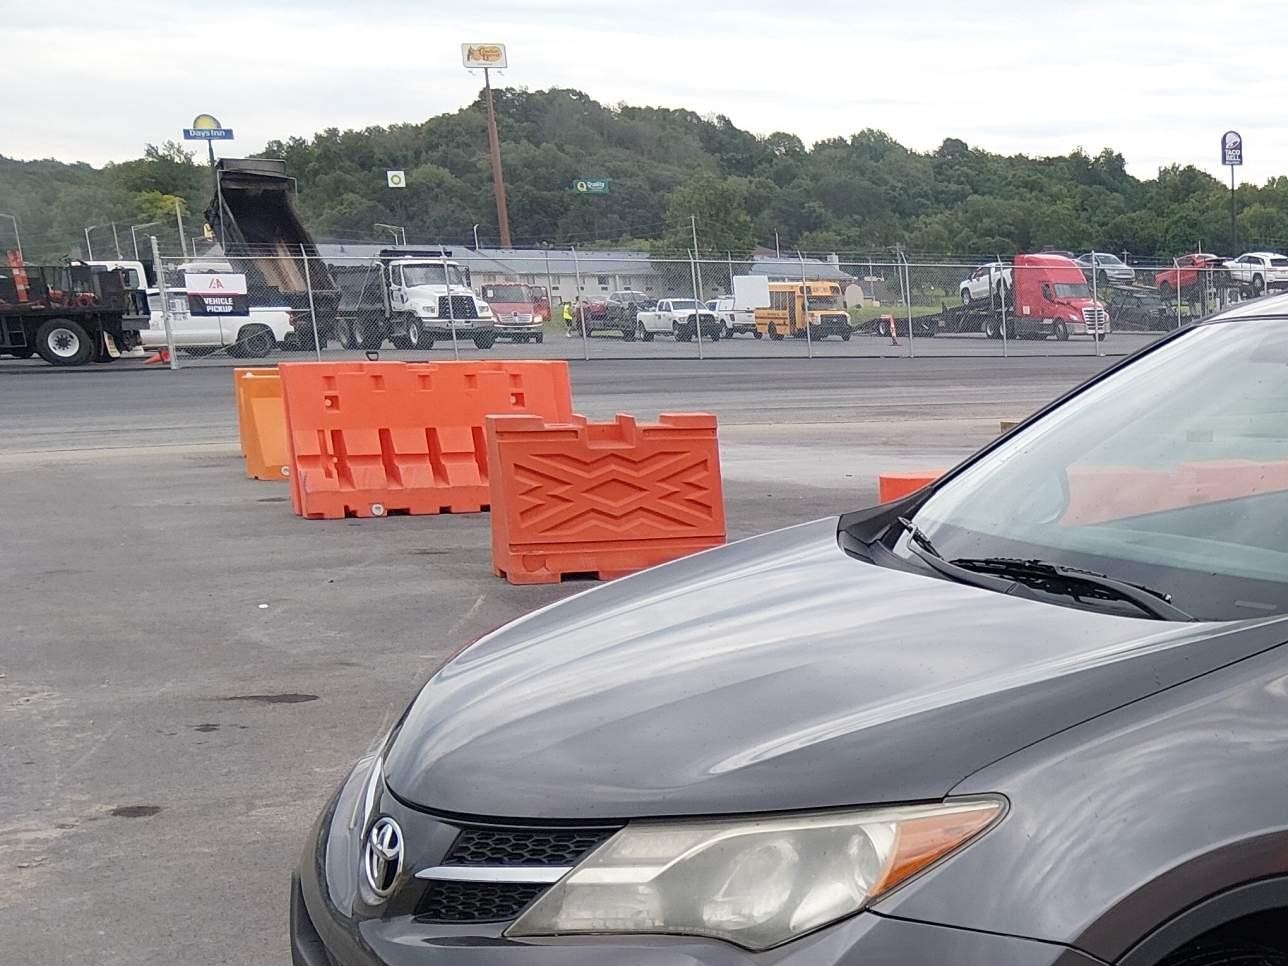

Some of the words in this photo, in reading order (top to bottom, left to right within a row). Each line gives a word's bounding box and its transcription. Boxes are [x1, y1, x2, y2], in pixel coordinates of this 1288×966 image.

[189, 129, 210, 138] Days
[210, 129, 225, 137] Inn
[203, 297, 233, 305] VEHICLE
[206, 305, 233, 313] PICKUP
